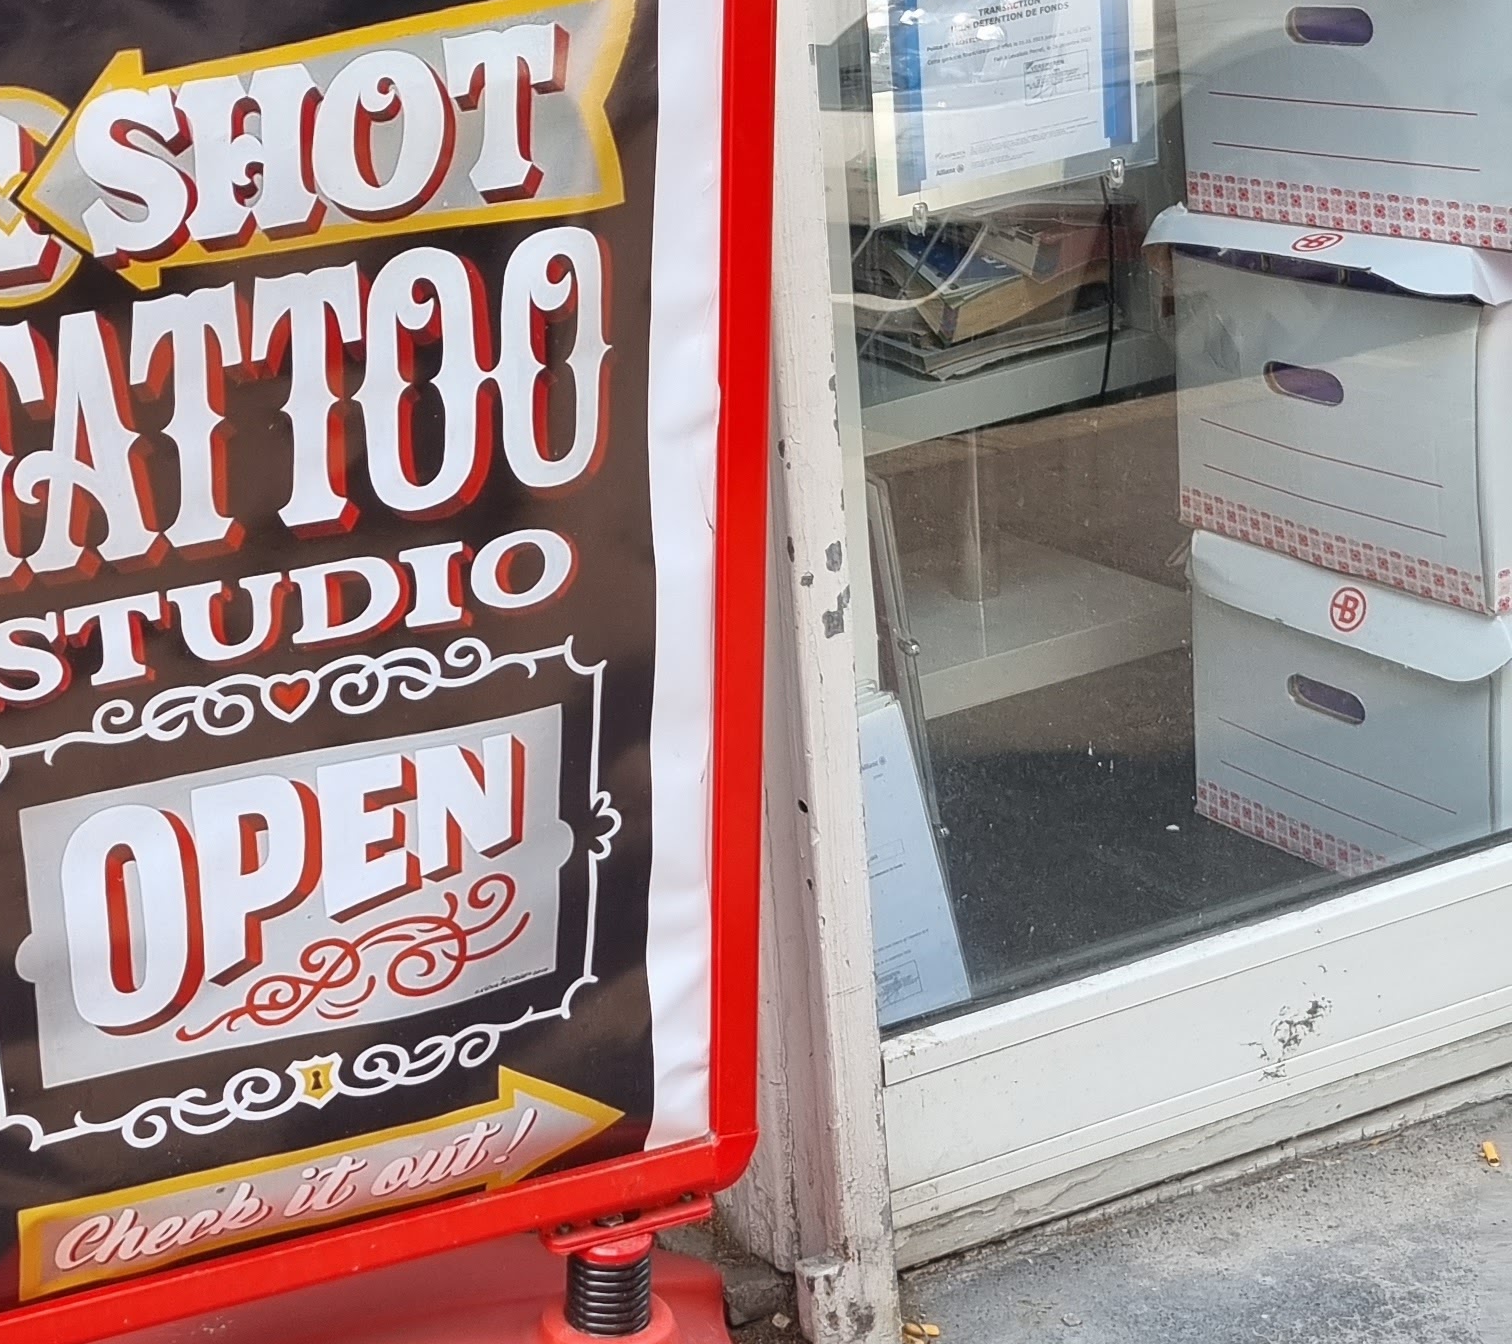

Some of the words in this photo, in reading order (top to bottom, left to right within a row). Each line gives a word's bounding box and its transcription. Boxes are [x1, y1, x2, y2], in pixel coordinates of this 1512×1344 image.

[973, 12, 1024, 29] DETENTION
[1025, 8, 1038, 19] DE
[1039, 1, 1070, 16] FONDS
[73, 22, 569, 271] SHOT
[61, 733, 525, 1035] OPEN
[54, 1182, 272, 1272] Check
[283, 1156, 368, 1217] it
